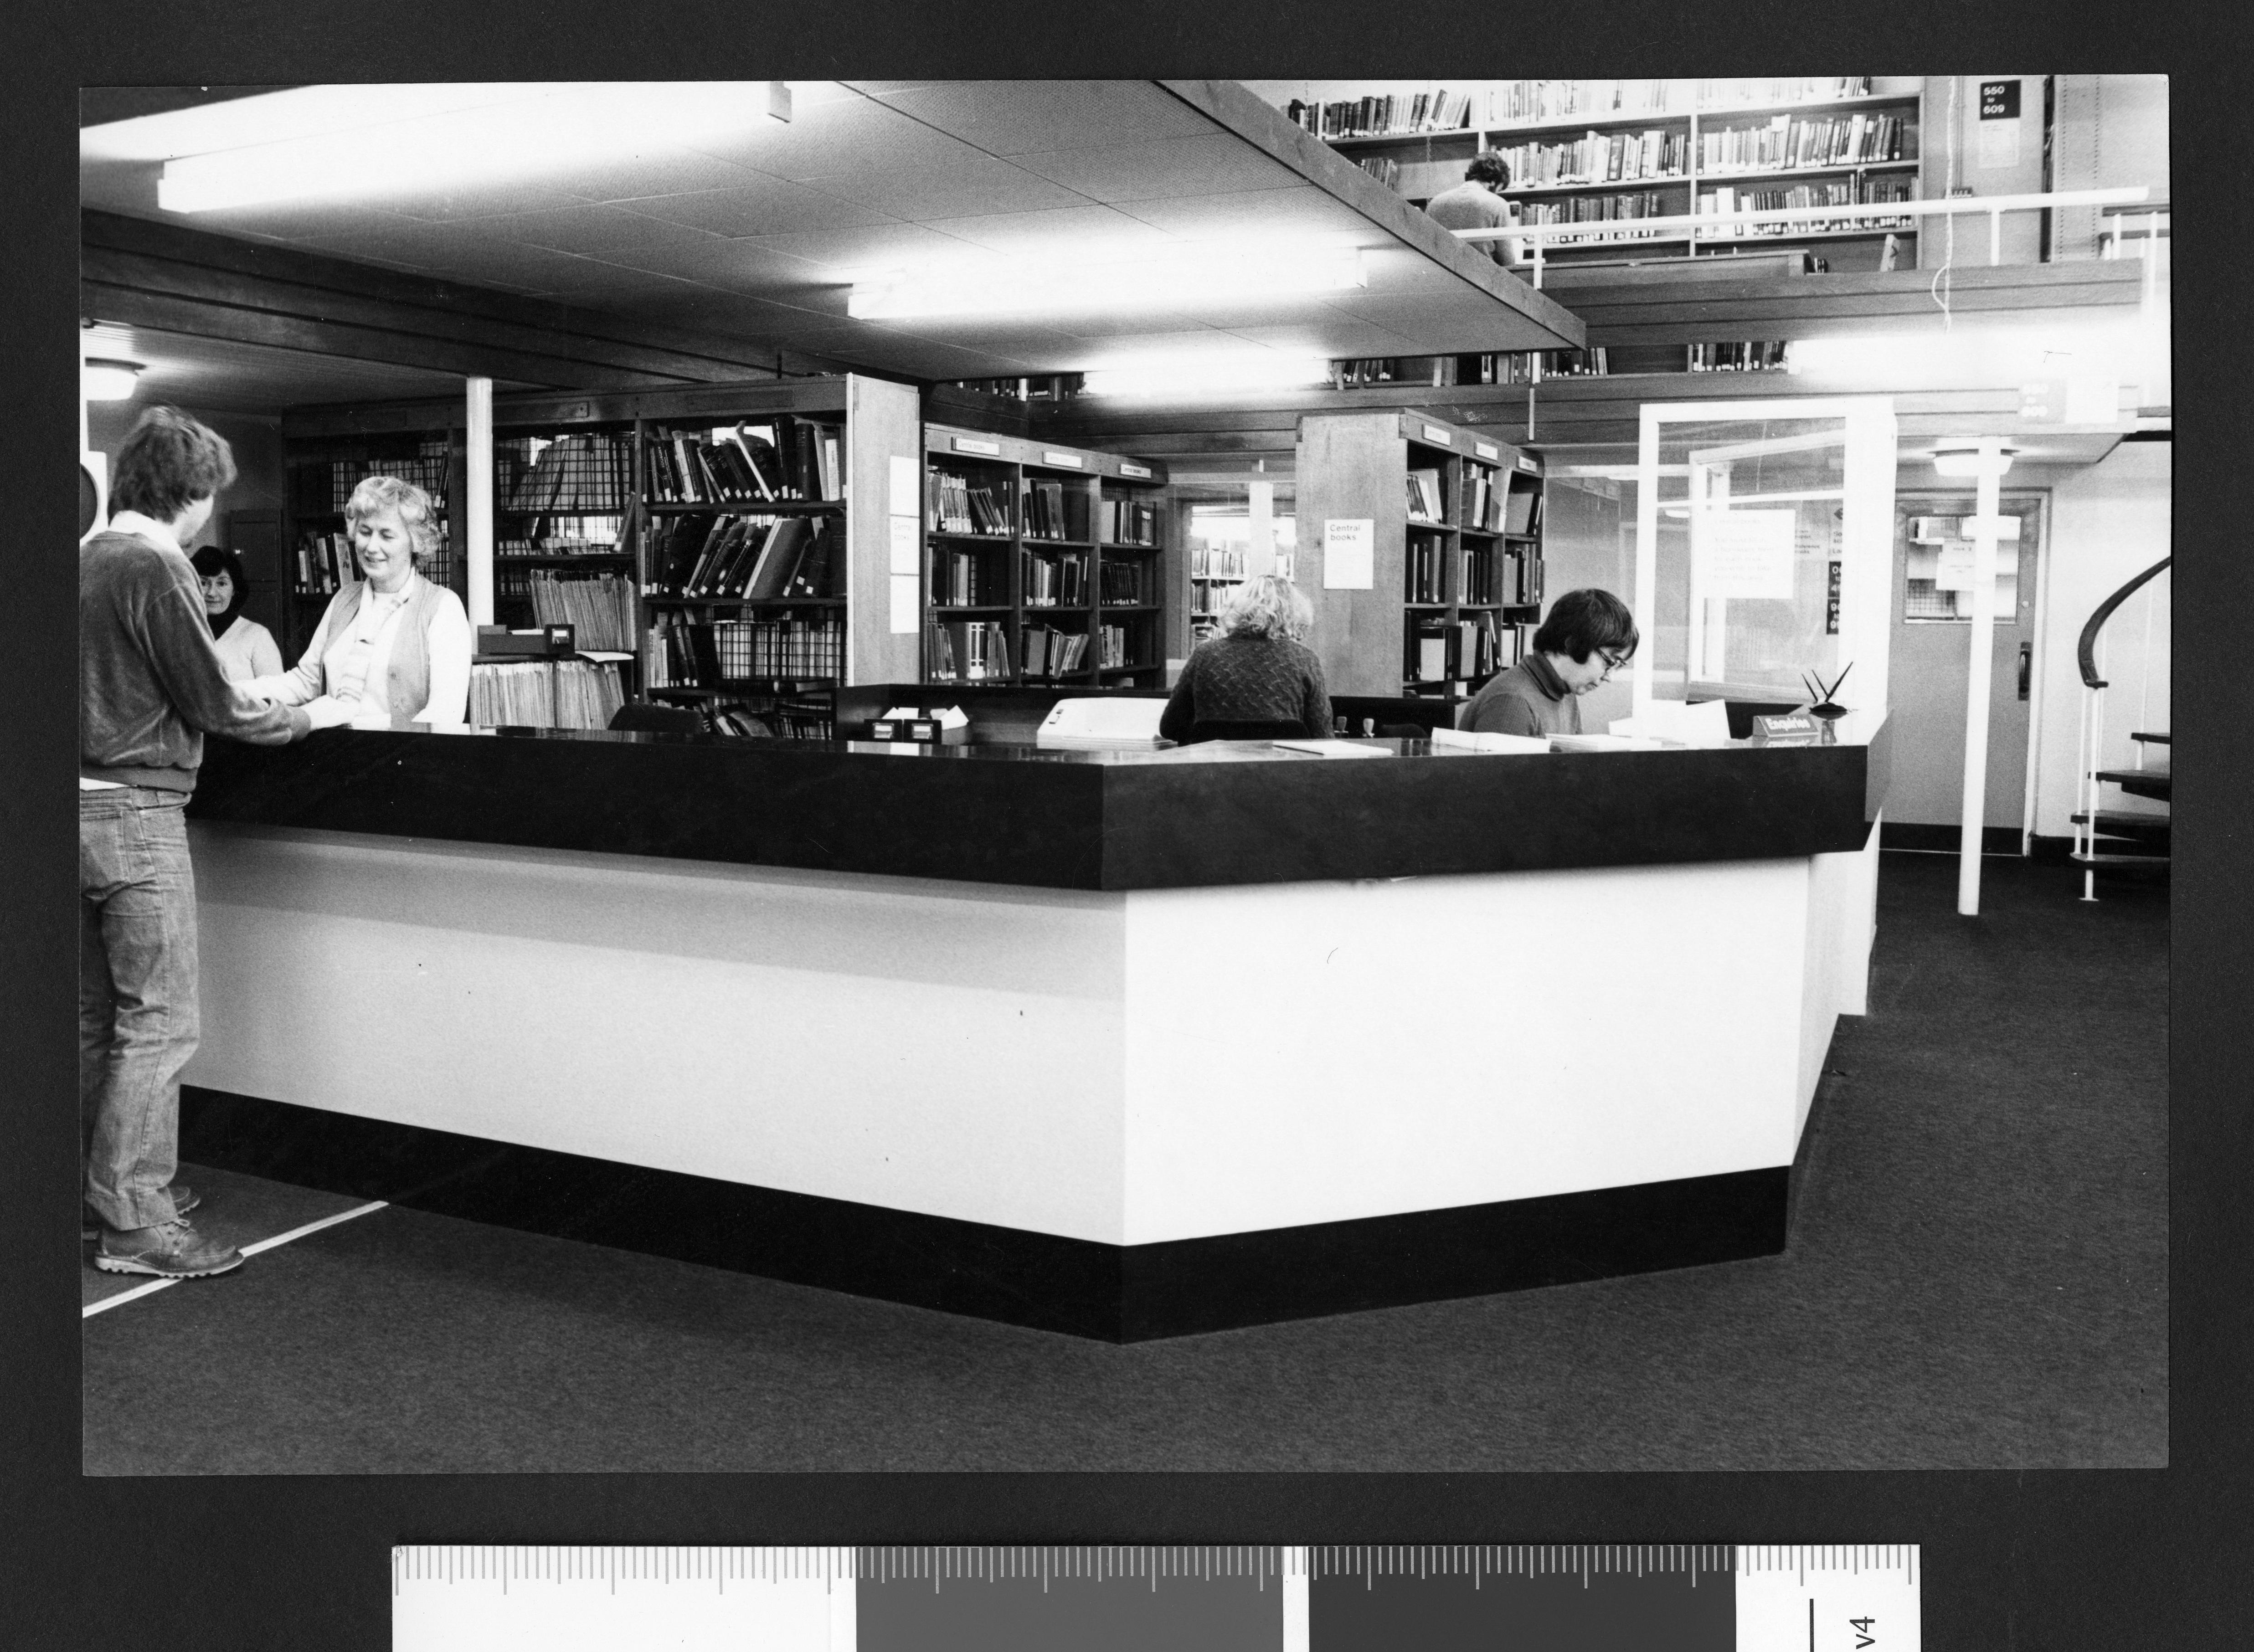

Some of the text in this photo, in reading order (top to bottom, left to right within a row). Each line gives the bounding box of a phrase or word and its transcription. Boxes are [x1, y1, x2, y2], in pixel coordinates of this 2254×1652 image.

[1984, 85, 2005, 96] 550
[1983, 104, 2005, 114] 609
[1765, 716, 1811, 731] Enquiries
